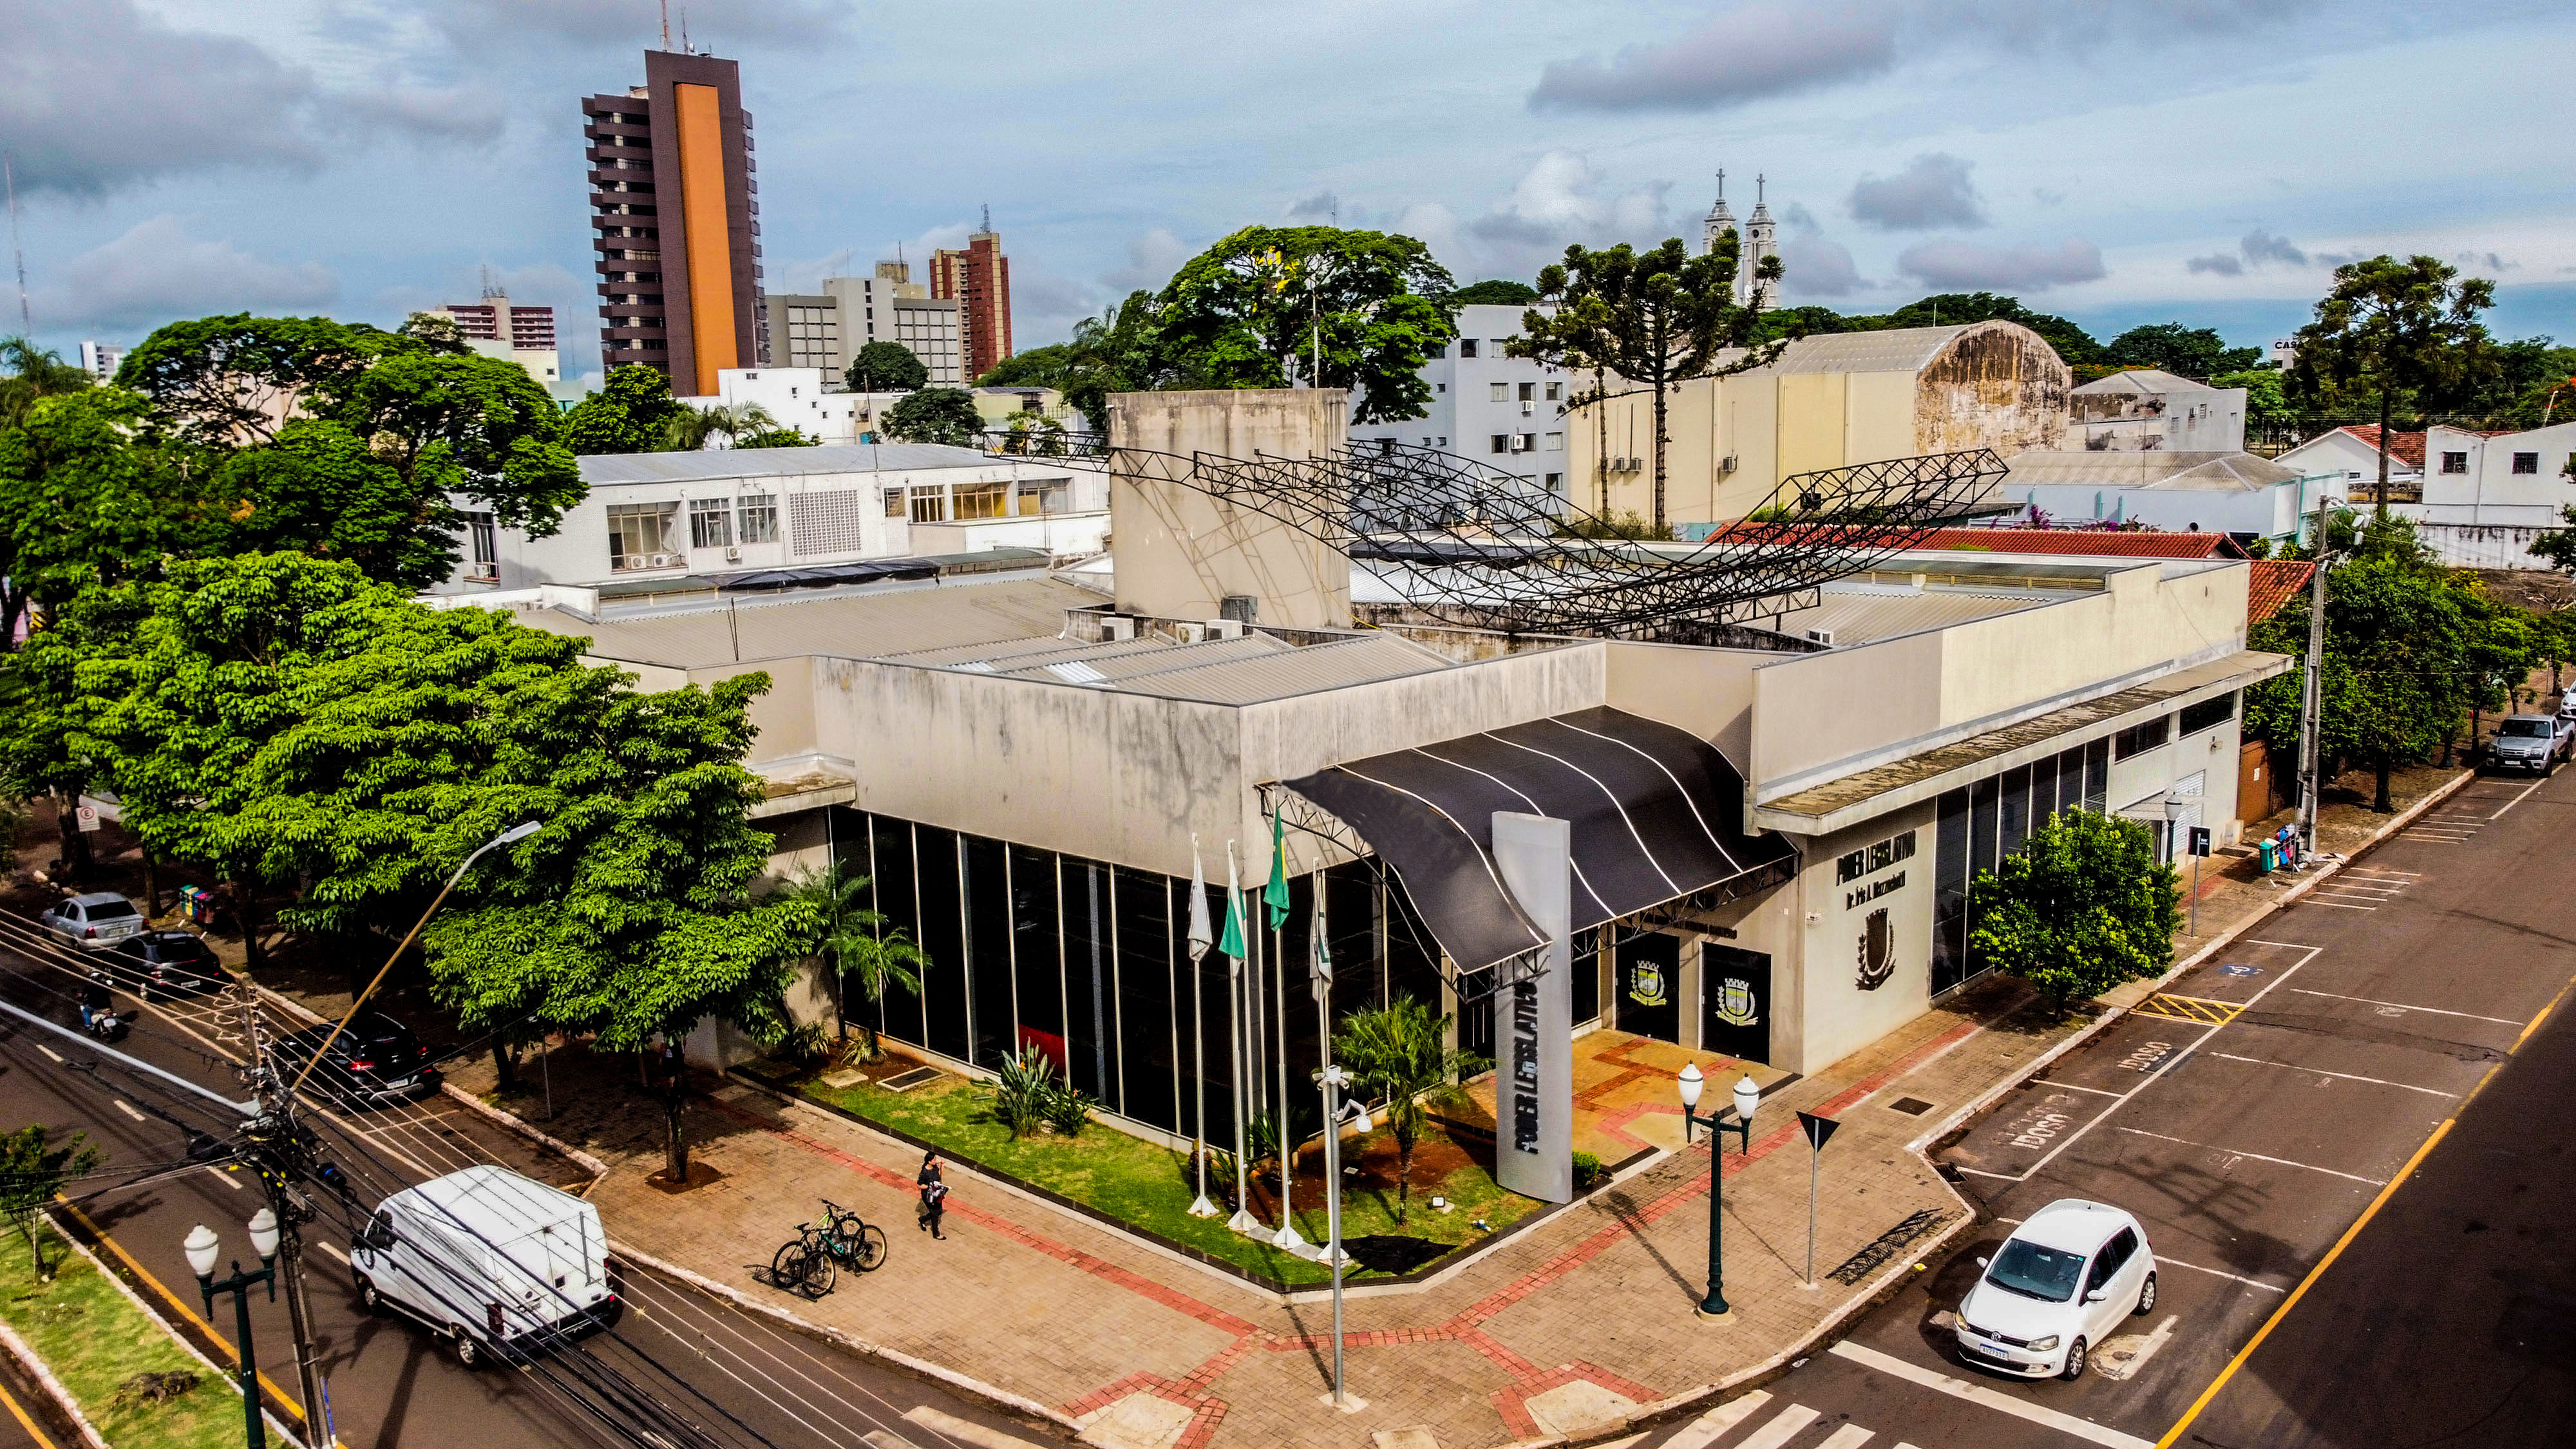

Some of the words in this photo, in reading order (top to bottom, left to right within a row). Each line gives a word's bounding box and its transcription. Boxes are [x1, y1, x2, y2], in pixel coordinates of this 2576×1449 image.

[1836, 849, 1864, 887] PODER
[1865, 829, 1916, 875] LEGISLATIVO
[1514, 981, 1538, 1095] LEGISLATIVO
[1515, 1094, 1539, 1155] PODER
